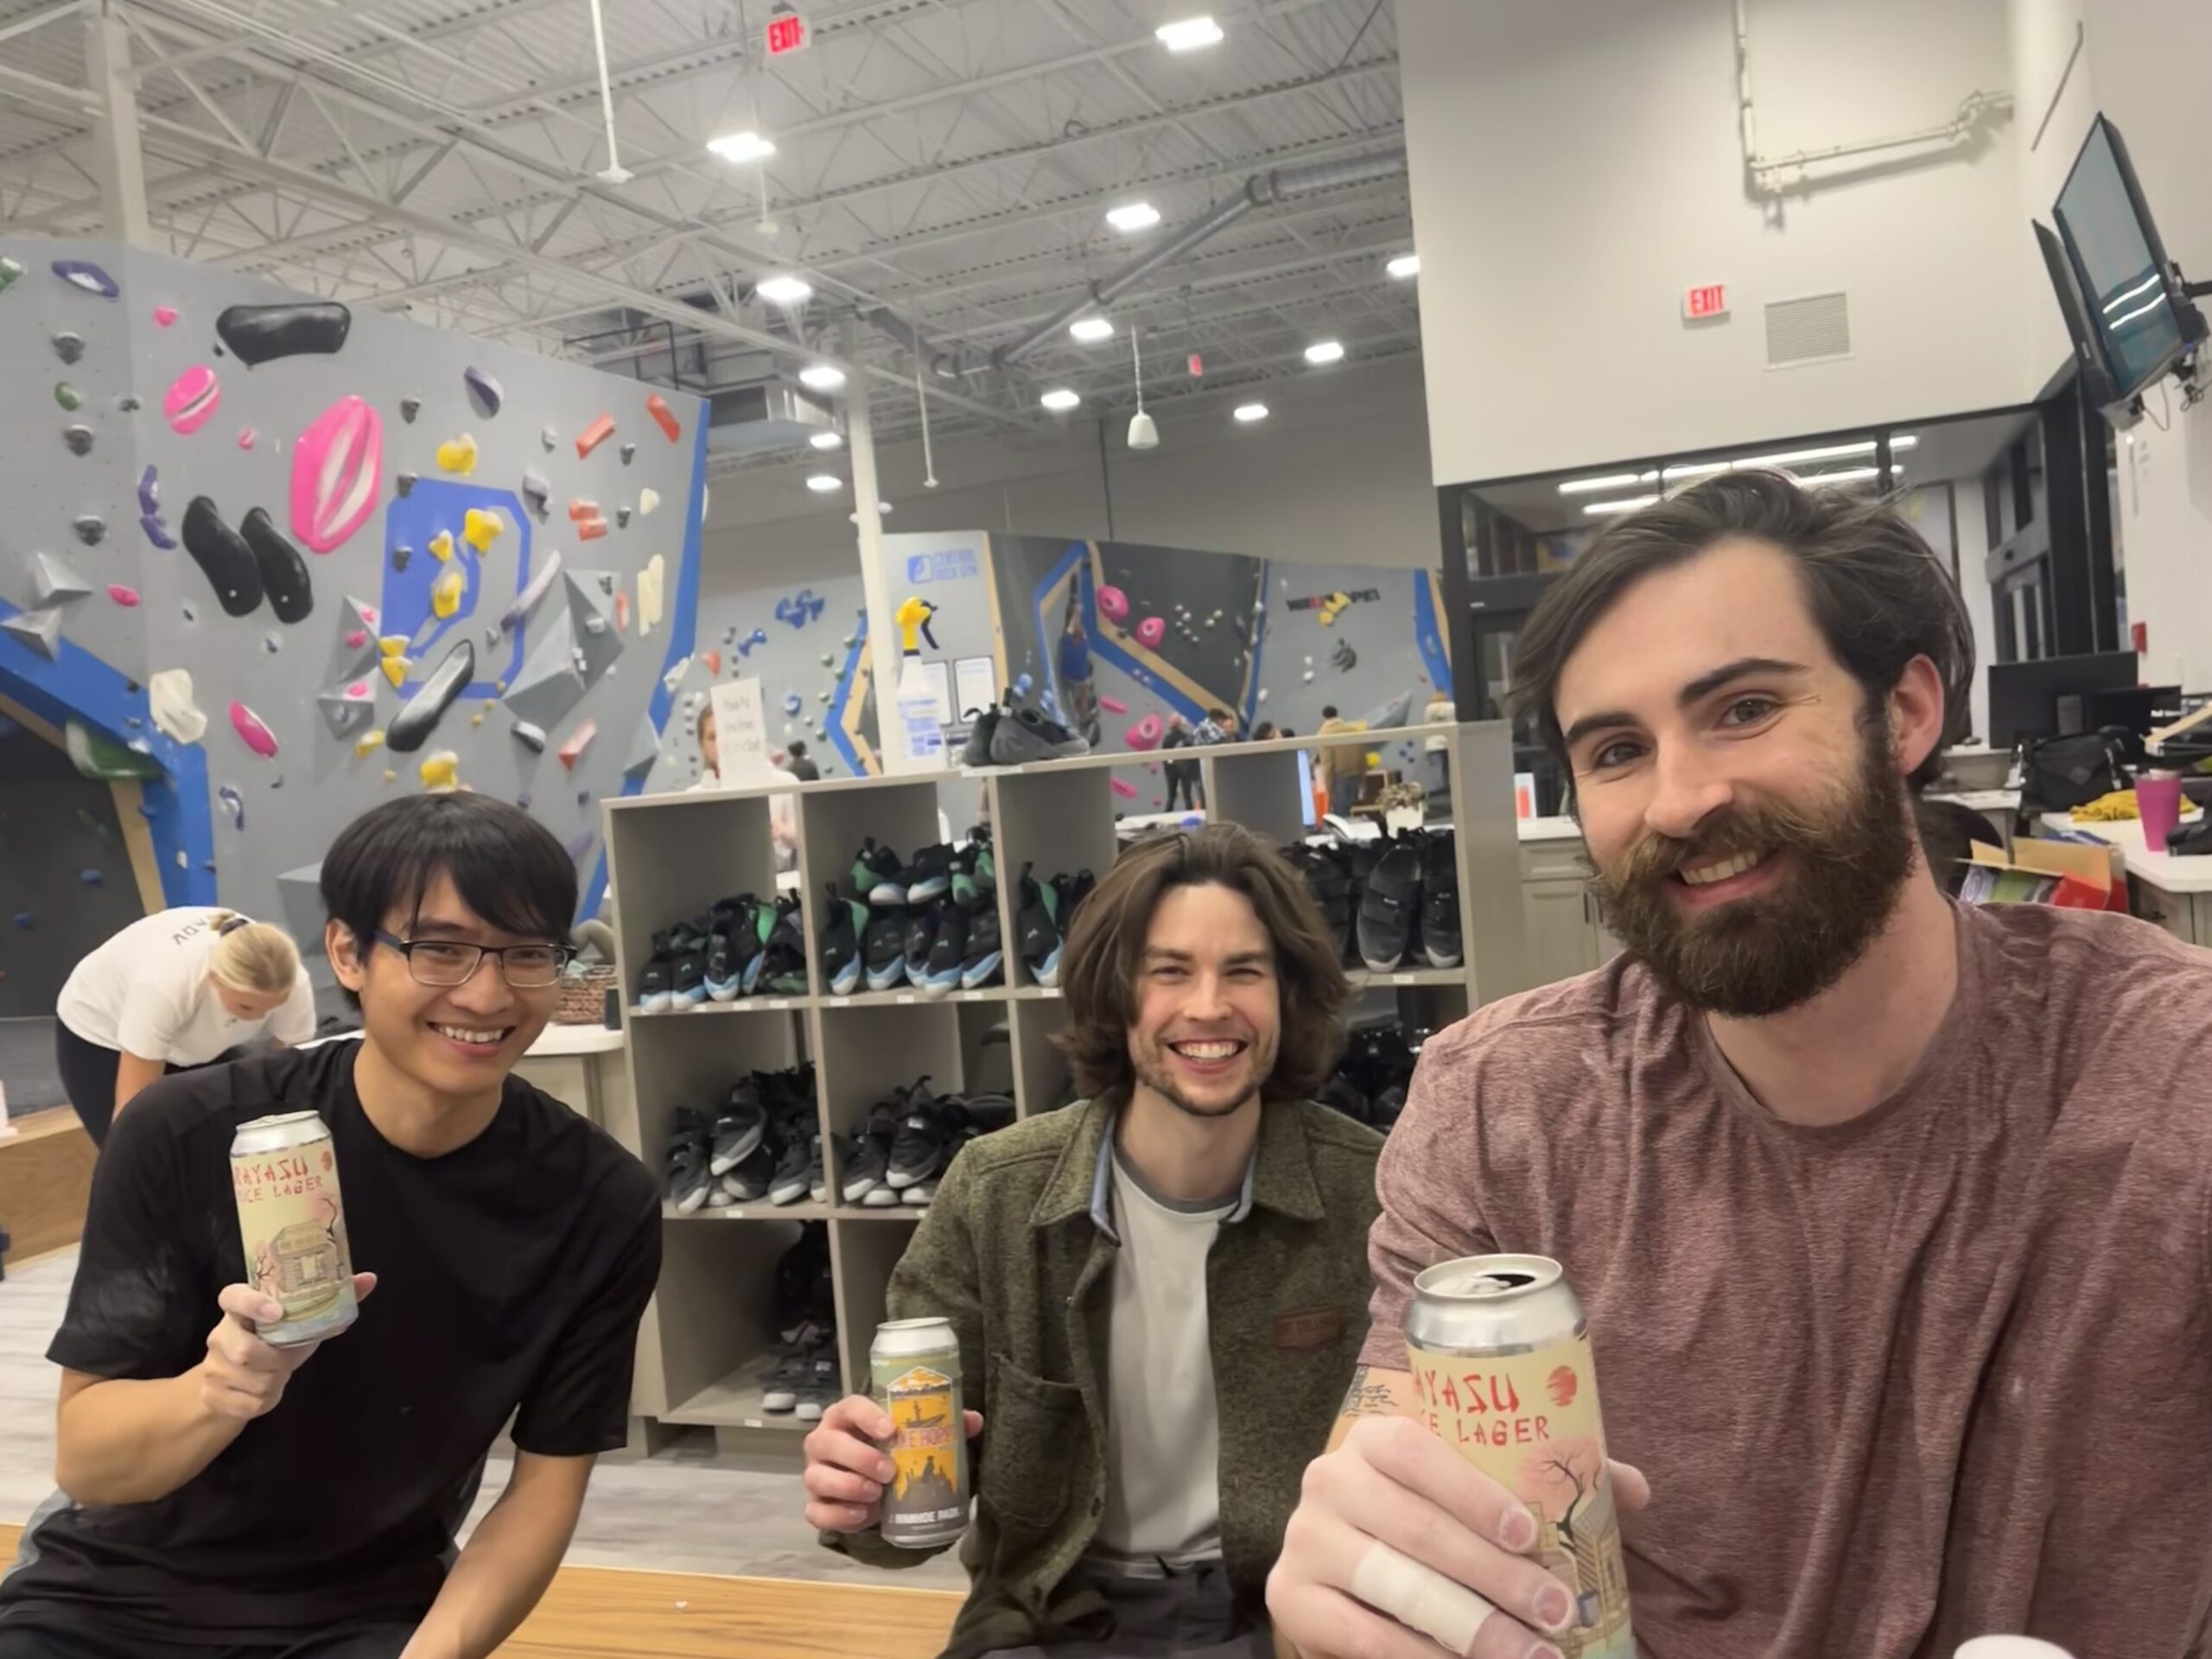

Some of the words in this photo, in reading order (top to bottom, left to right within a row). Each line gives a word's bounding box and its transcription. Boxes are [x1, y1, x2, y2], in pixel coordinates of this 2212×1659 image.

[768, 18, 800, 53] EXIT
[1691, 286, 1725, 315] EXIT
[274, 1176, 324, 1198] LAGER
[1457, 1415, 1549, 1446] LAGER
